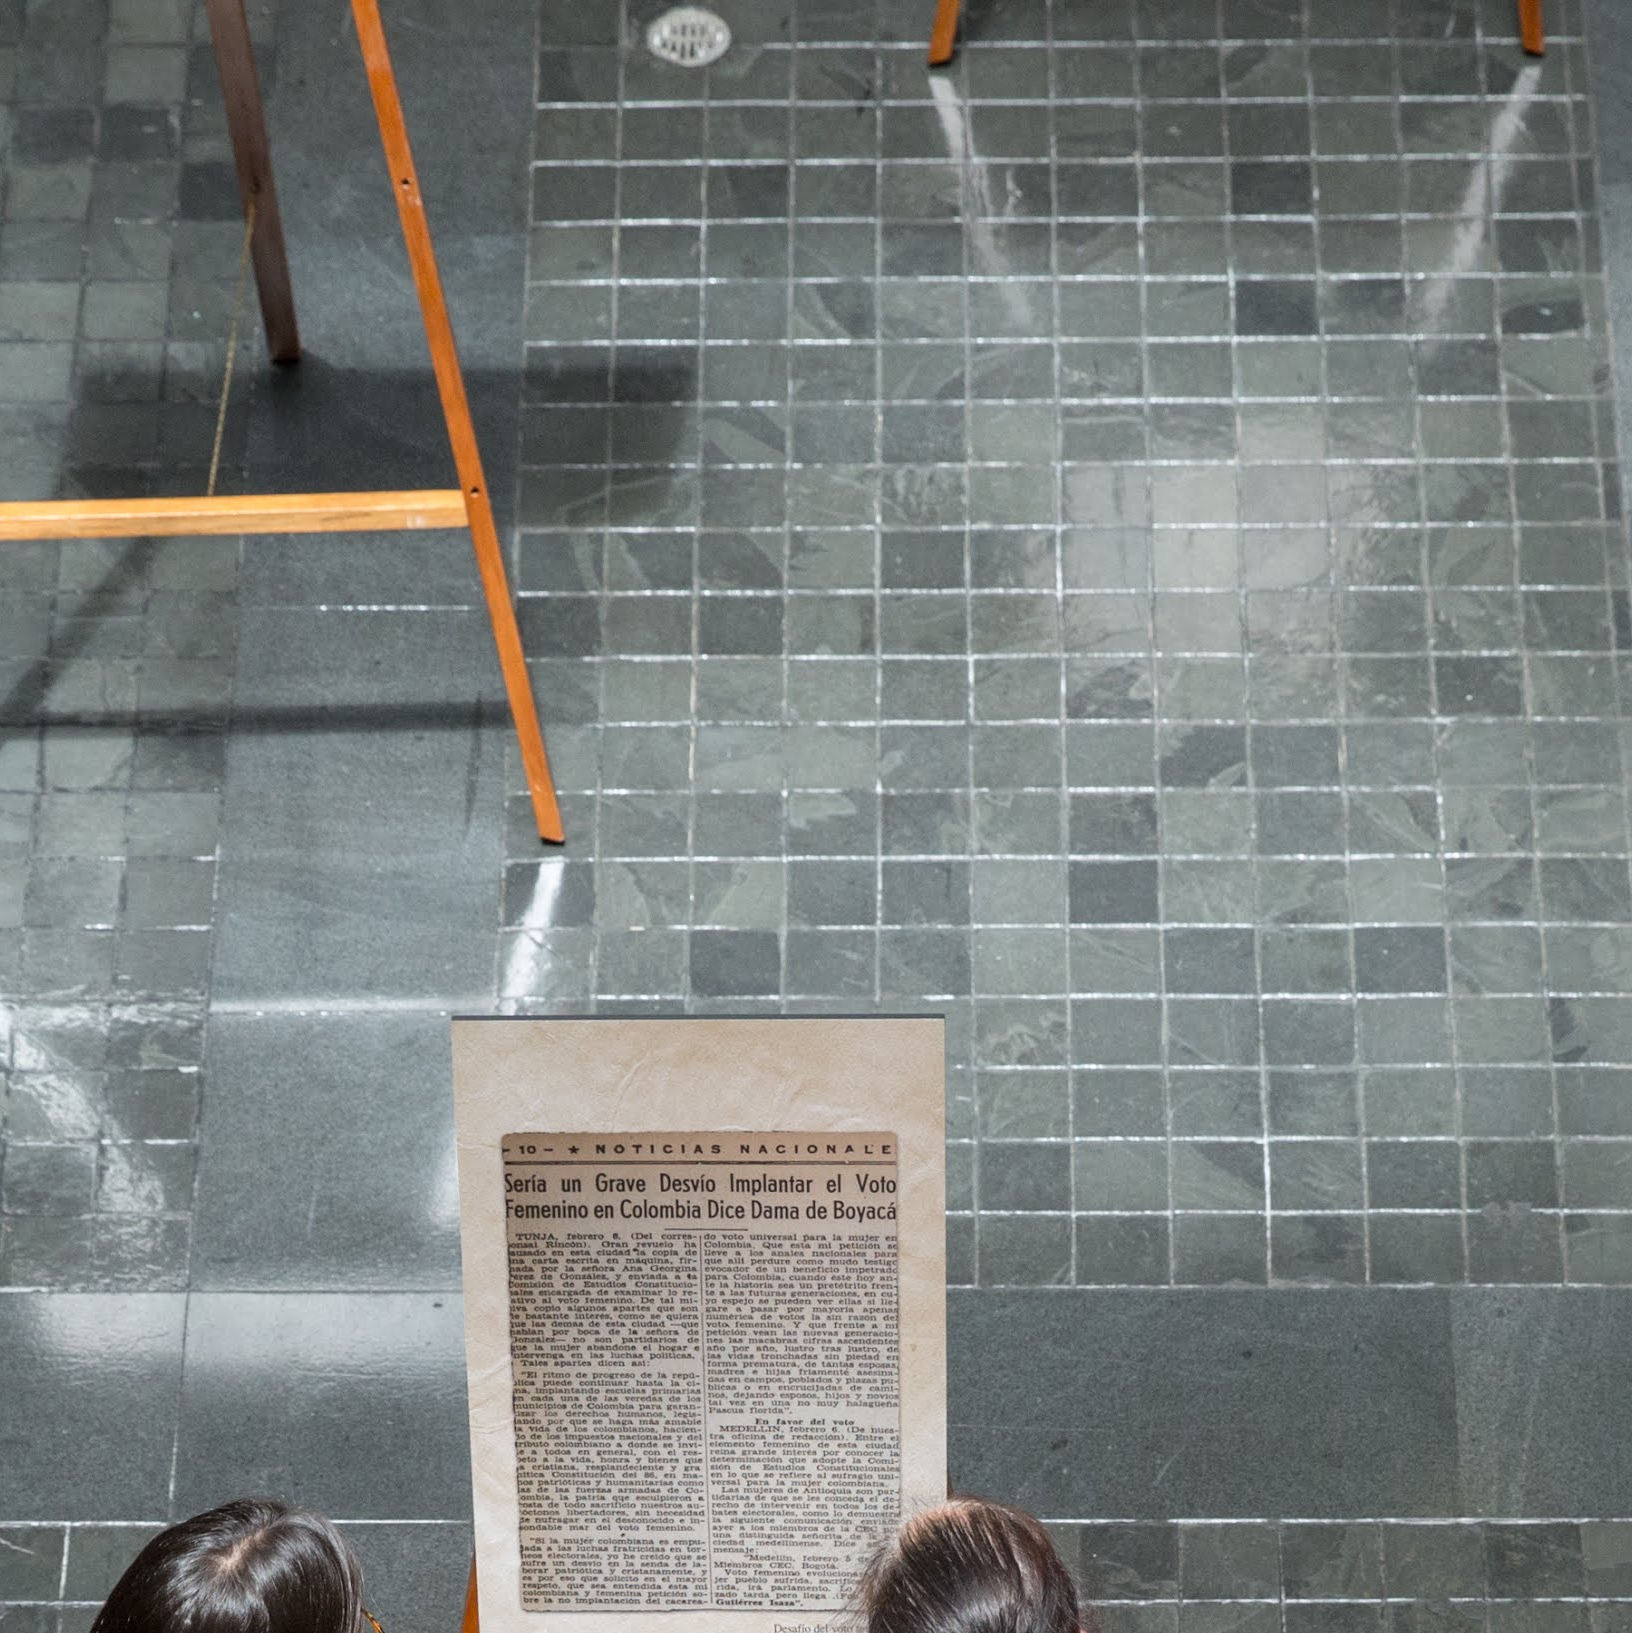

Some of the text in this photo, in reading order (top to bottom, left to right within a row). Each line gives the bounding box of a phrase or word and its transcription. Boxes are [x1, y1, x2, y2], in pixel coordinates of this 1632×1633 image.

[596, 1144, 721, 1155] NOTICIAS
[504, 1173, 896, 1196] Sería un Grave Desvío Implantar el Voto
[505, 1199, 896, 1223] Femenino en Colombia Dice Dama de Boyacá
[554, 1360, 592, 1368] apartes
[598, 1359, 625, 1367] dicen
[774, 1624, 810, 1633] Desafío
[814, 1624, 828, 1633] del
